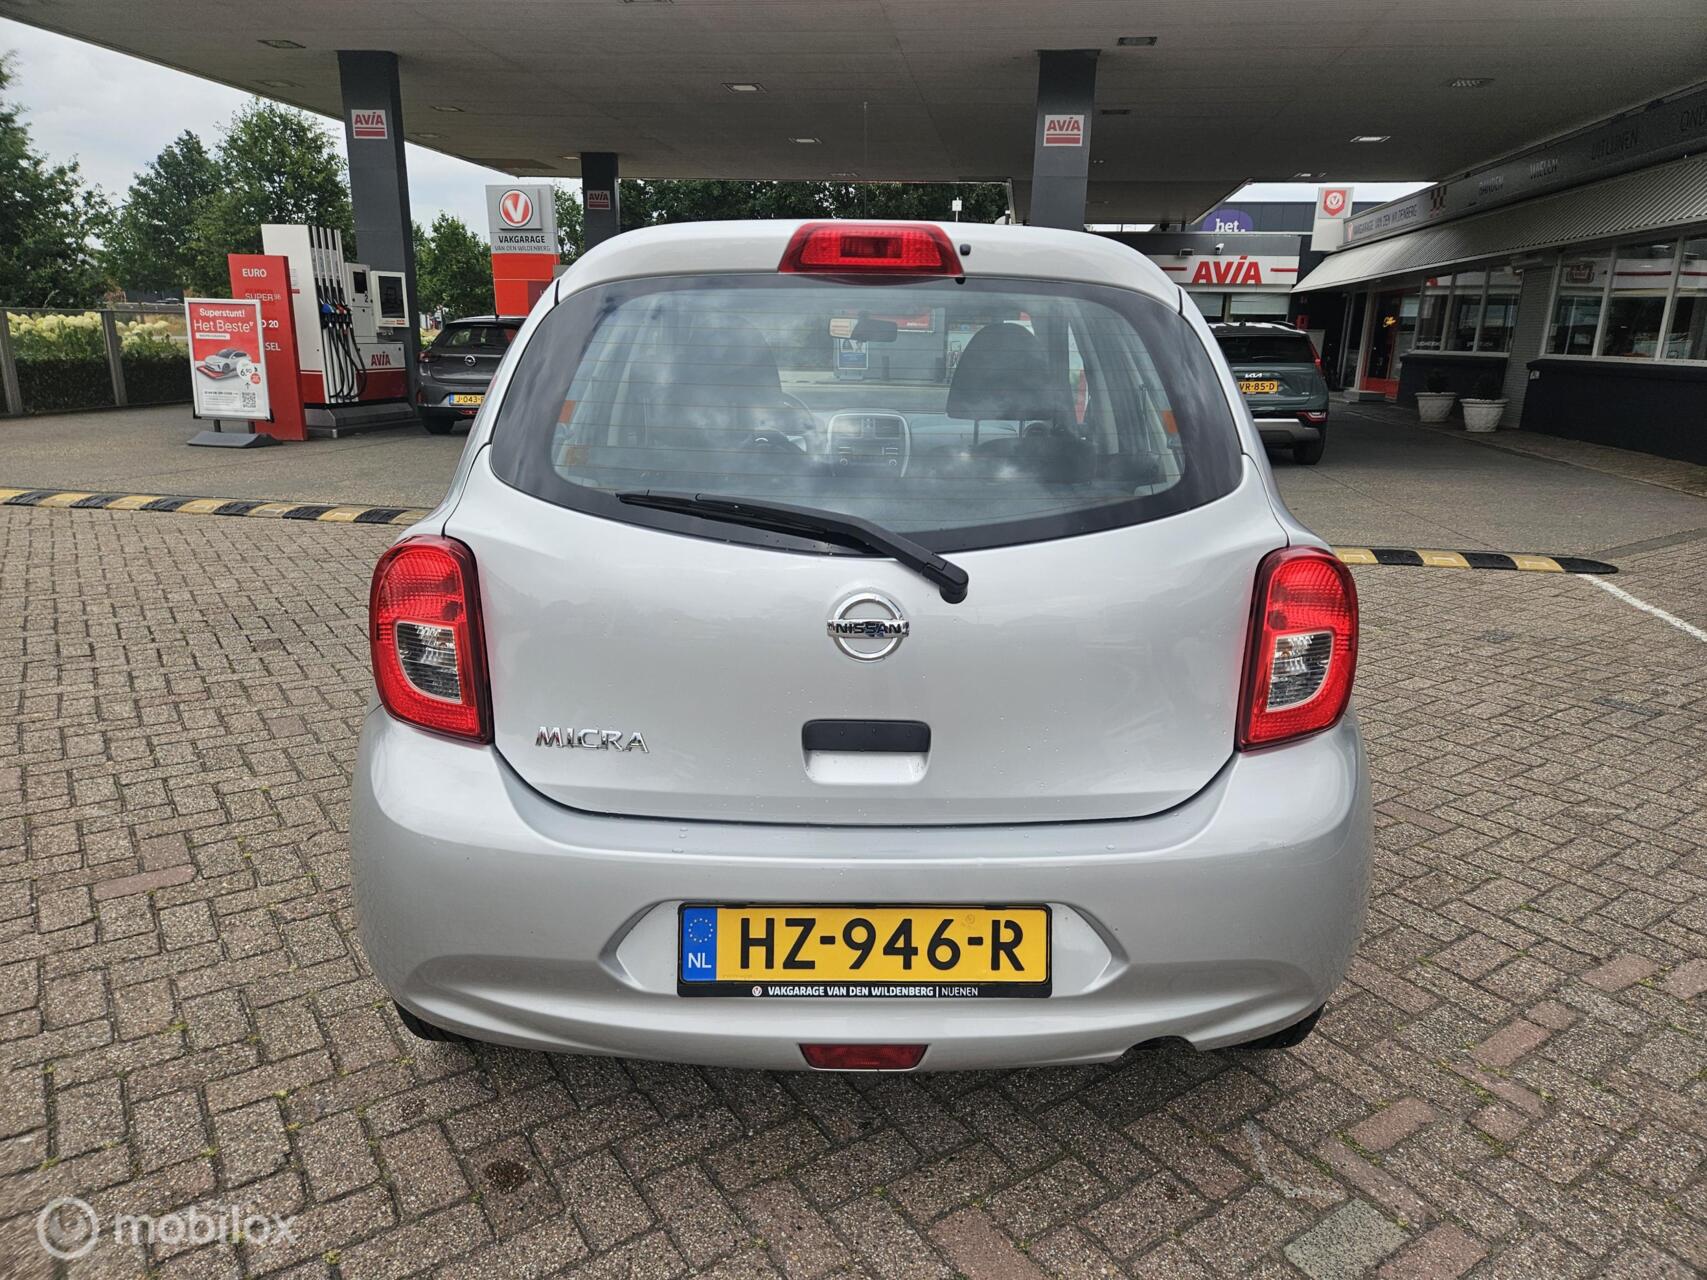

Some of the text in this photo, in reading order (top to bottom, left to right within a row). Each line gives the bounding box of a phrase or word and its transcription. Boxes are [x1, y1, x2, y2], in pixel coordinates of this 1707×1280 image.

[498, 235, 546, 244] VAKGARAGE
[242, 268, 267, 278] EURO
[199, 307, 246, 318] Superstunt!
[193, 319, 215, 331] Het
[268, 320, 279, 328] 20
[836, 623, 902, 634] NISSAN
[535, 726, 650, 754] MICRA
[740, 917, 1026, 972] HZ-946-R
[687, 952, 712, 969] NL
[767, 985, 979, 997] VAKGARAGE VAN DEN WILDENBERG NUENEN
